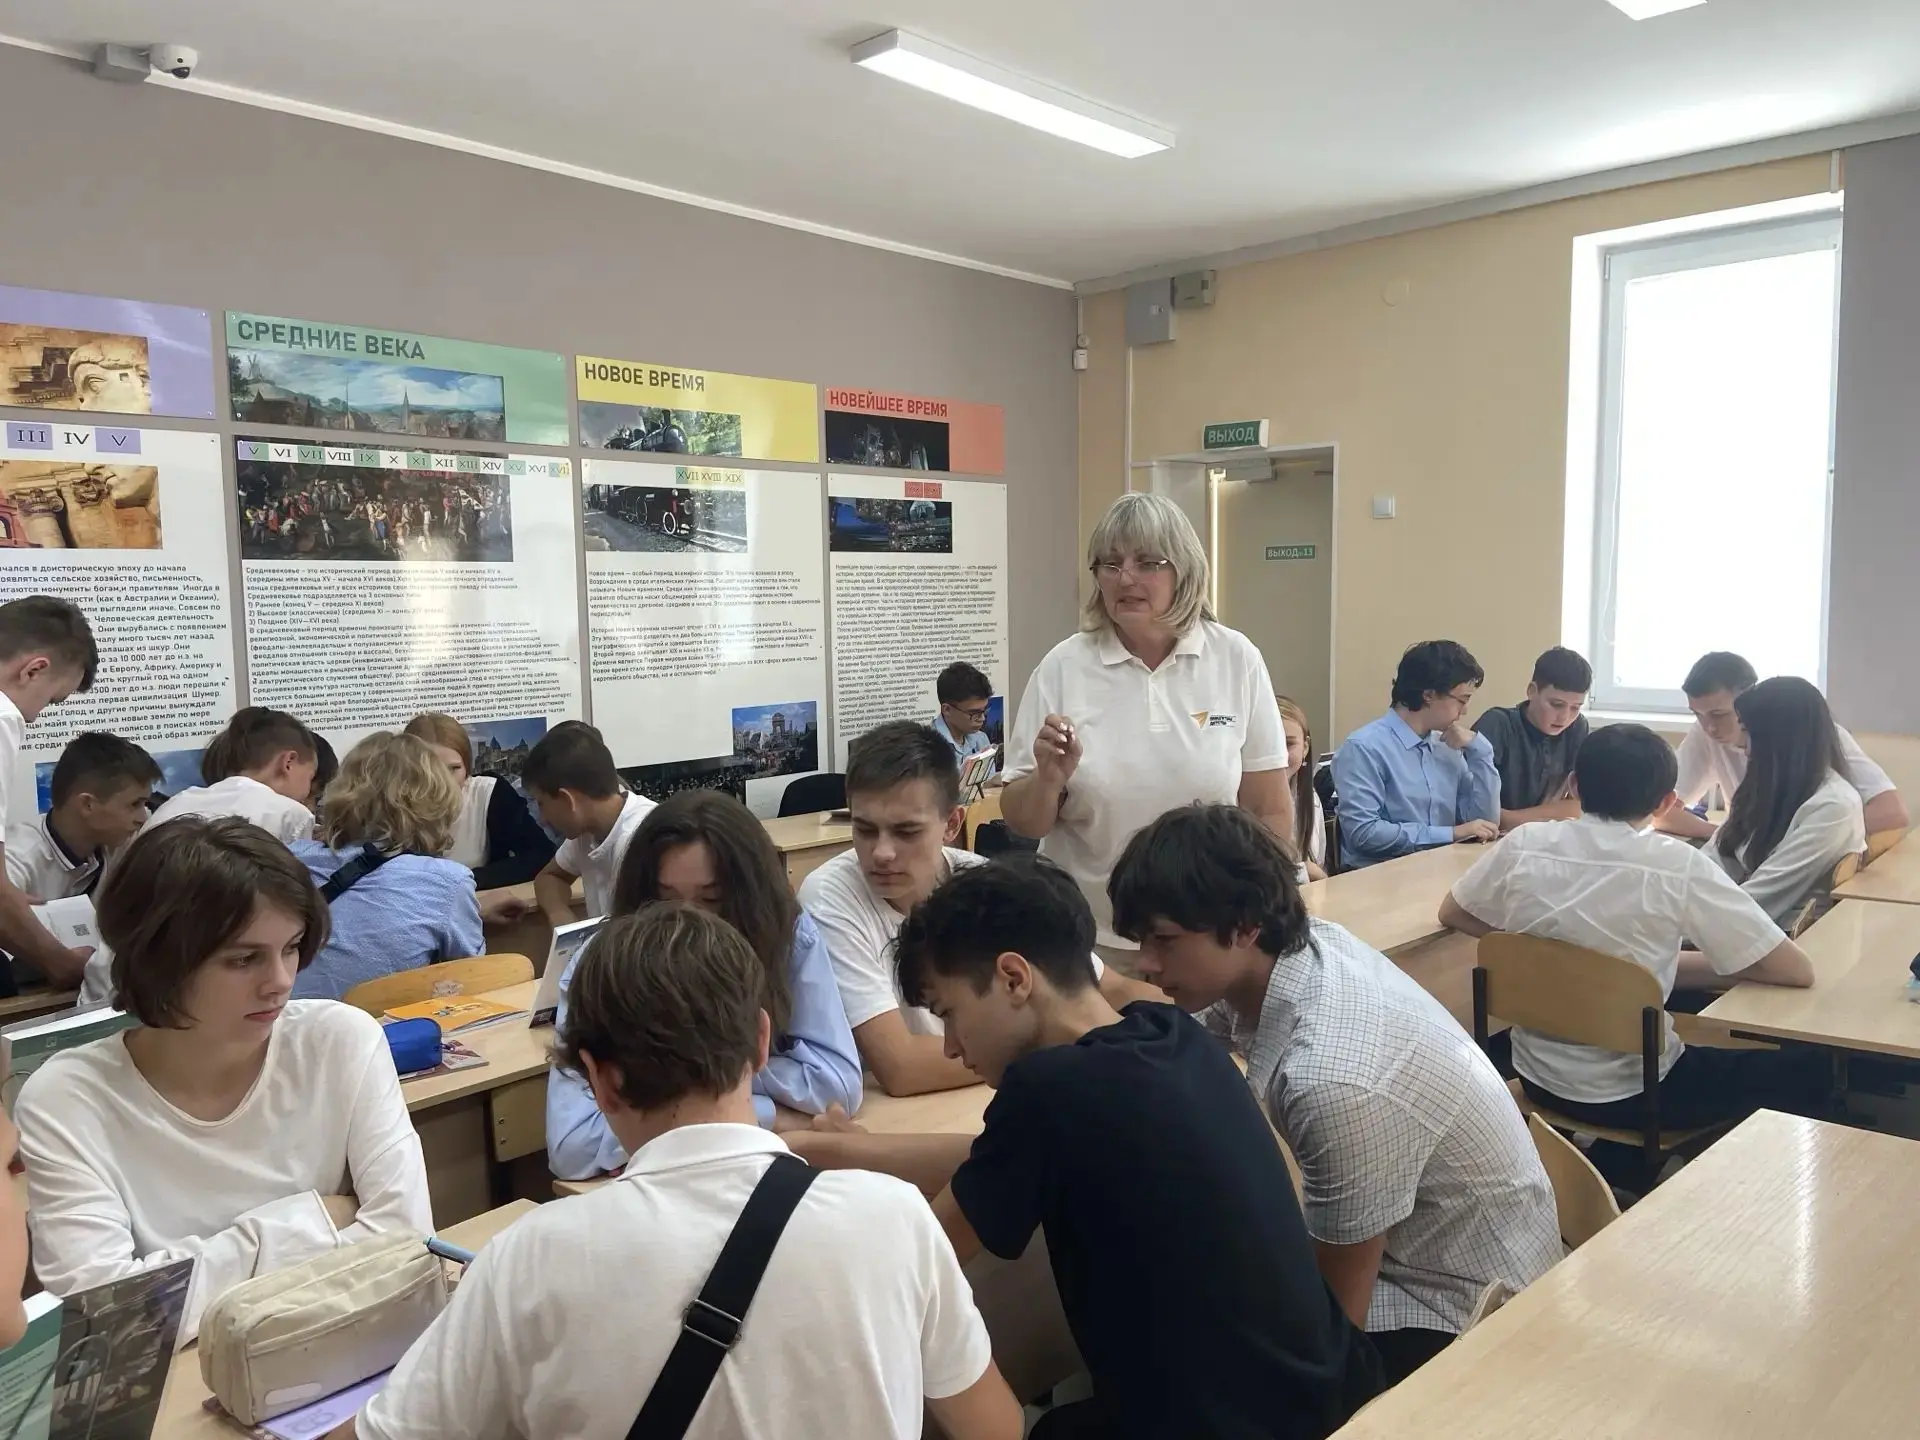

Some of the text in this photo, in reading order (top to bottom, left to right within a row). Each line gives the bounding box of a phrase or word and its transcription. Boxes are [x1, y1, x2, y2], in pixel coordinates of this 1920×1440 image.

[237, 320, 426, 360] СРЕДНИЕ ВЕКА
[585, 363, 705, 392] НОВОЕ ВРЕМЯ
[830, 390, 947, 417] НОВЕЙШЕЕ ВРЕМЯ
[16, 429, 127, 447] III IV V
[1208, 427, 1254, 443] ВЫХОД
[248, 446, 260, 456] V
[273, 448, 293, 458] VI
[300, 449, 323, 460] VII
[326, 450, 353, 462] VIII
[360, 453, 375, 462] IX
[389, 455, 399, 464] X
[412, 456, 426, 466] XI
[434, 457, 454, 468] XII
[458, 459, 479, 470] XIII
[481, 460, 503, 471] XIV
[508, 462, 523, 472] XV
[527, 464, 547, 474] XVI
[677, 470, 700, 481] XVII
[724, 472, 742, 483] XIX
[1268, 548, 1298, 558] ВЫХОД
[40, 565, 115, 573] доисторическую
[116, 565, 142, 573] эпоху
[143, 565, 155, 573] до
[41, 586, 92, 594] монументы
[182, 584, 213, 592] Иногда
[124, 594, 170, 603] Австралии
[178, 603, 209, 611] Совсем
[94, 614, 214, 623] Человеческая деятельность
[97, 625, 115, 633] Они
[117, 624, 168, 633] вырубались
[176, 622, 227, 631] появлением
[146, 634, 172, 642] тысяч
[189, 632, 215, 640] назад
[179, 662, 214, 671] Америку
[116, 672, 152, 684] круглый
[153, 674, 169, 682] год
[182, 672, 210, 680] одном
[183, 680, 219, 689] перешли
[98, 696, 130, 705] первая
[130, 692, 188, 702] цивилизация
[96, 706, 127, 716] другие
[128, 703, 167, 712] причины
[168, 700, 216, 710] вынуждали
[69, 716, 106, 728] уходили
[120, 714, 148, 722] новые
[150, 712, 176, 720] земли
[118, 724, 154, 733] полисов
[163, 722, 197, 730] поисках
[199, 719, 225, 728] новых
[142, 732, 163, 742] свой
[190, 728, 218, 737] жизни
